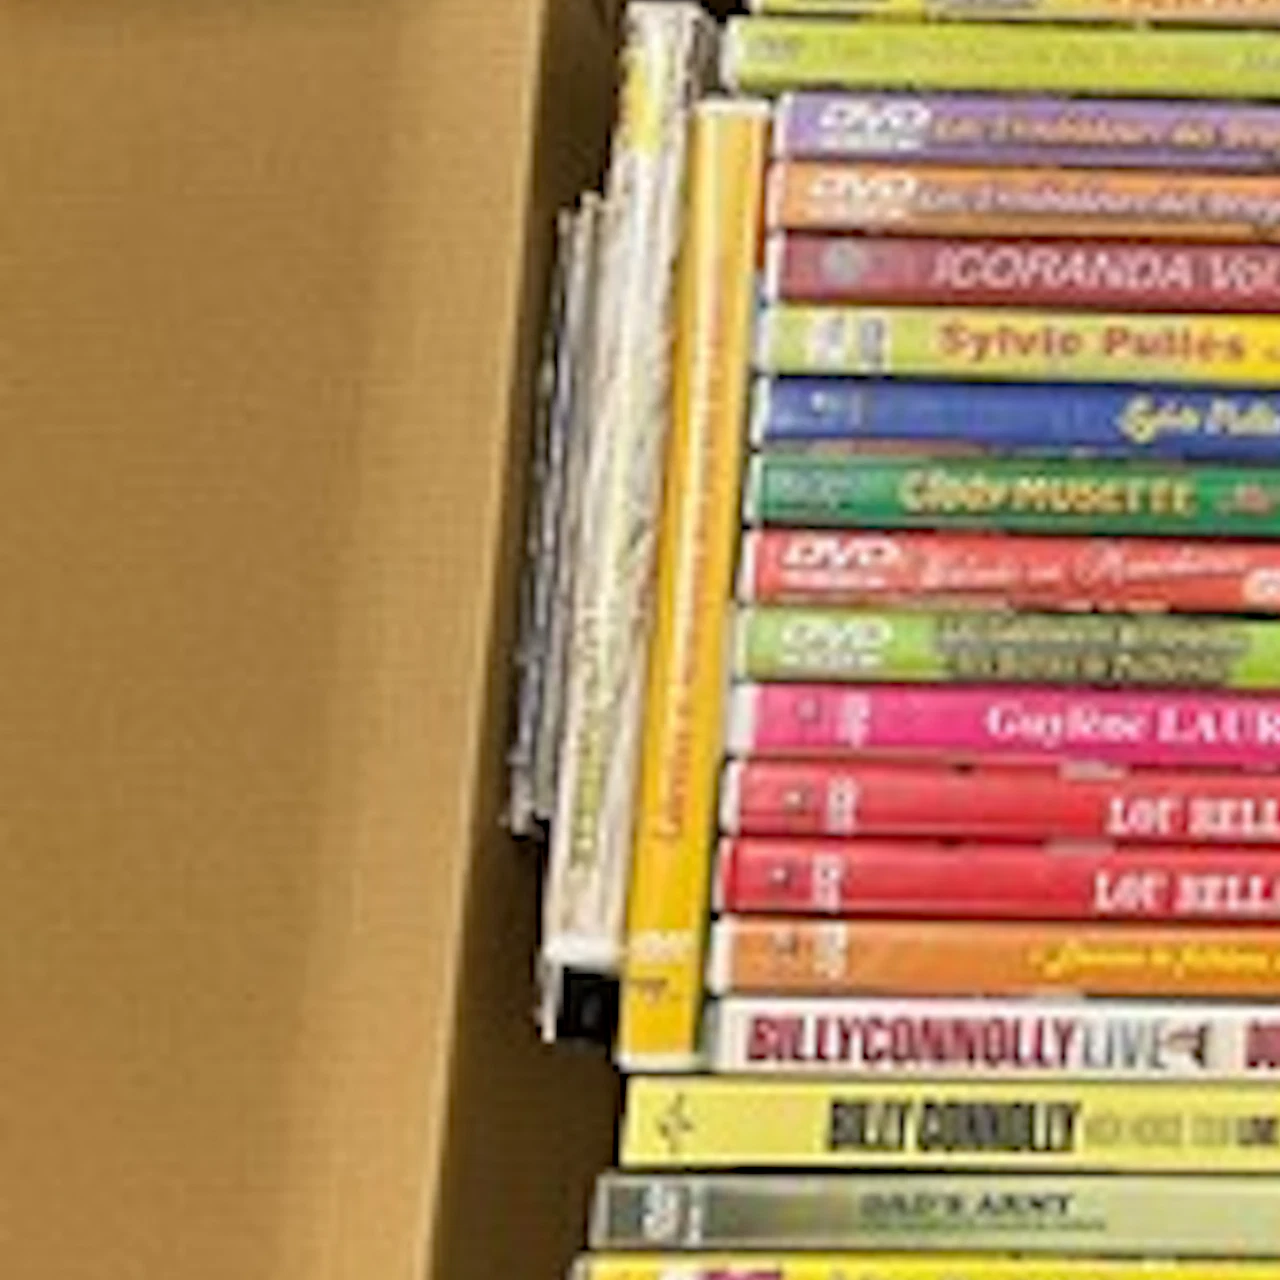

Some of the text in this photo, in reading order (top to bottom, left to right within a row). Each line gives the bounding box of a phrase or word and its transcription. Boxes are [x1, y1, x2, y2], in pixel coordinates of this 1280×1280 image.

[822, 100, 930, 131] DVD
[808, 173, 918, 200] DVD
[934, 249, 1193, 293] ICORANDA
[939, 323, 1080, 363] Sylvie
[783, 538, 903, 570] DVD
[781, 620, 893, 653] DVD
[985, 702, 1146, 748] Guylène
[1107, 798, 1181, 836] LOU
[1094, 873, 1167, 911] LOU
[1082, 1023, 1168, 1070] LIVE
[831, 1100, 913, 1150] BILLY
[918, 1101, 1082, 1152] CONNOLLY
[859, 1192, 1075, 1217] DAD'S ARMY
